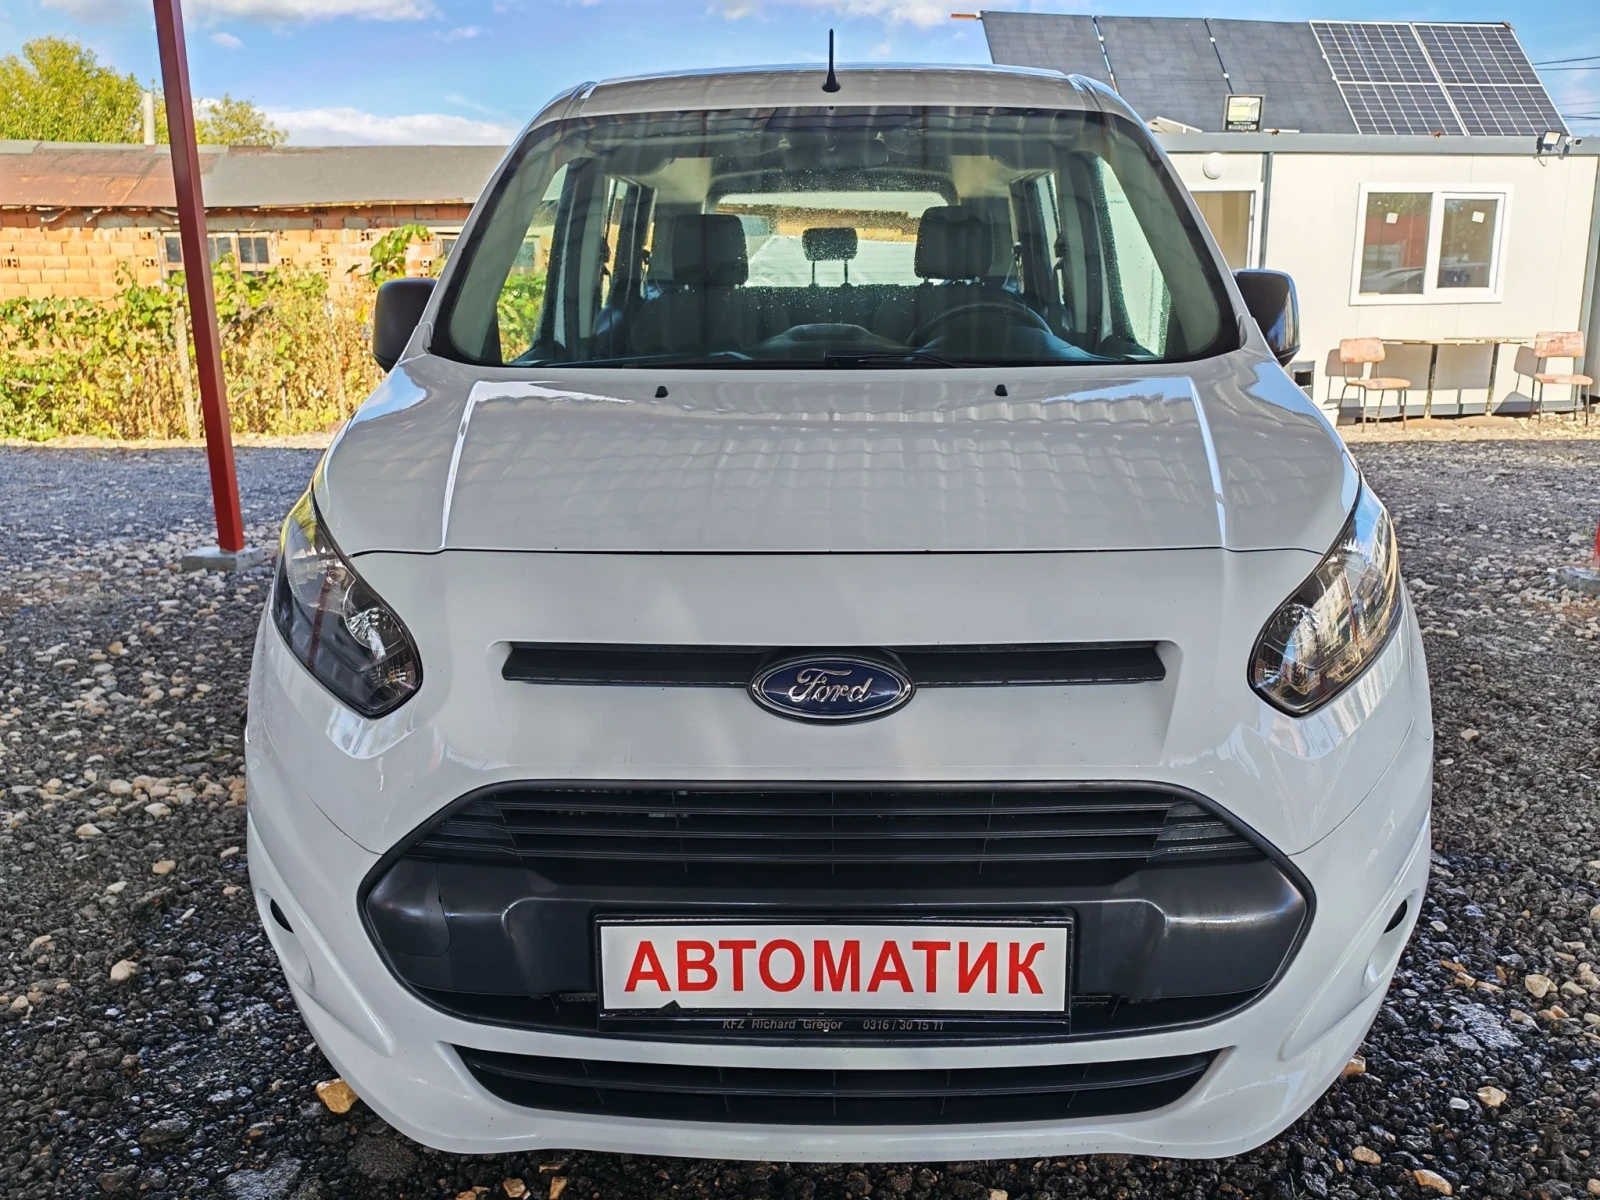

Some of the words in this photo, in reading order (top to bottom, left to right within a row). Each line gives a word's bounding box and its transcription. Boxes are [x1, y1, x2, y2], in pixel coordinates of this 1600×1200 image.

[787, 668, 873, 702] Ford
[624, 938, 1046, 995] АВТОМАТИК
[722, 1018, 745, 1029] KFZ
[751, 1018, 796, 1029] Richard
[802, 1018, 843, 1032] Gregor
[862, 1019, 889, 1030] 0316
[899, 1019, 913, 1030] 30
[917, 1020, 929, 1030] 15
